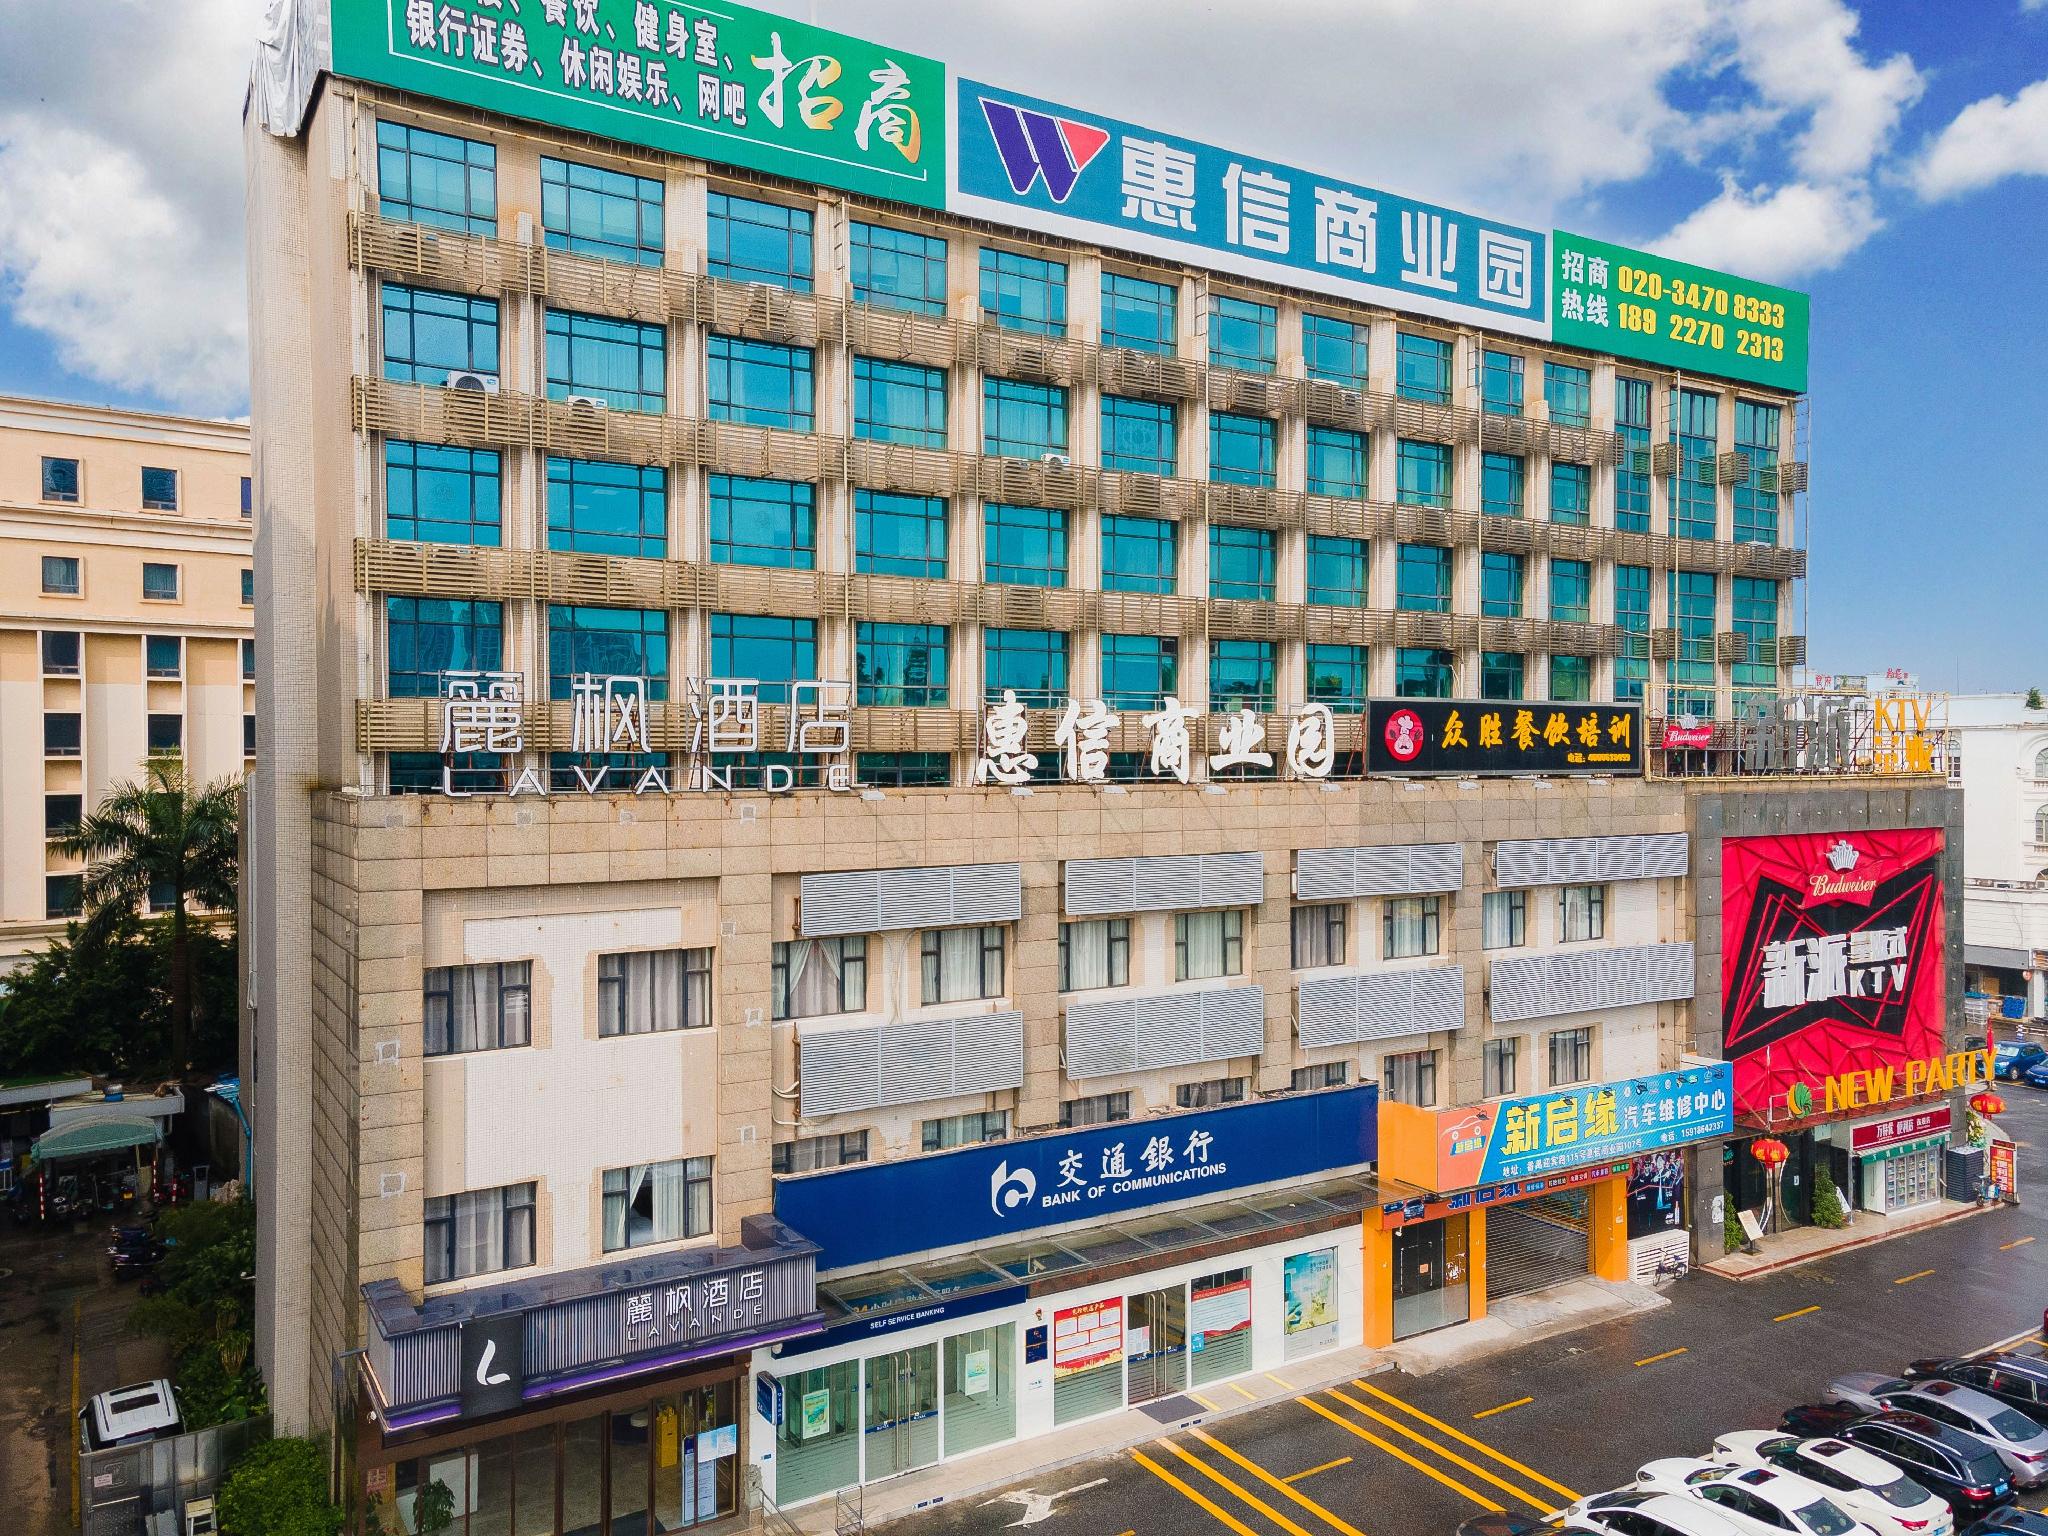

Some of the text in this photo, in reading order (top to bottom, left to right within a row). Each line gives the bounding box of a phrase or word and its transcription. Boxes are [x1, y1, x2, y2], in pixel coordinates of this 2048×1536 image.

[751, 32, 923, 164] 招商
[1121, 134, 1532, 310] 惠信商业园
[1562, 249, 1610, 289] 招商
[1562, 288, 1609, 328] 热线
[1618, 265, 1785, 329] 020-3470 8333
[1618, 303, 1784, 362] 189 2270 2313
[440, 670, 852, 754] 麗枫酒店
[1441, 709, 1632, 751] 众胜餐饮培训
[1875, 697, 1932, 733] KTV
[977, 690, 1335, 784] 惠信商业园
[1668, 730, 1710, 742] Budweiser
[1809, 873, 1878, 897] Budweiser
[1850, 963, 1908, 998] KTV
[1825, 1047, 1998, 1113] NEW PARTY
[1500, 1089, 1727, 1155] 新启缘 汽车维修中心
[1042, 1162, 1227, 1208] BANK OF COMMUNICATIONS
[626, 1271, 763, 1326] 麗枫酒店
[870, 1307, 945, 1330] SELF SERVICE BANKING
[627, 1304, 763, 1341] LAVANDE
